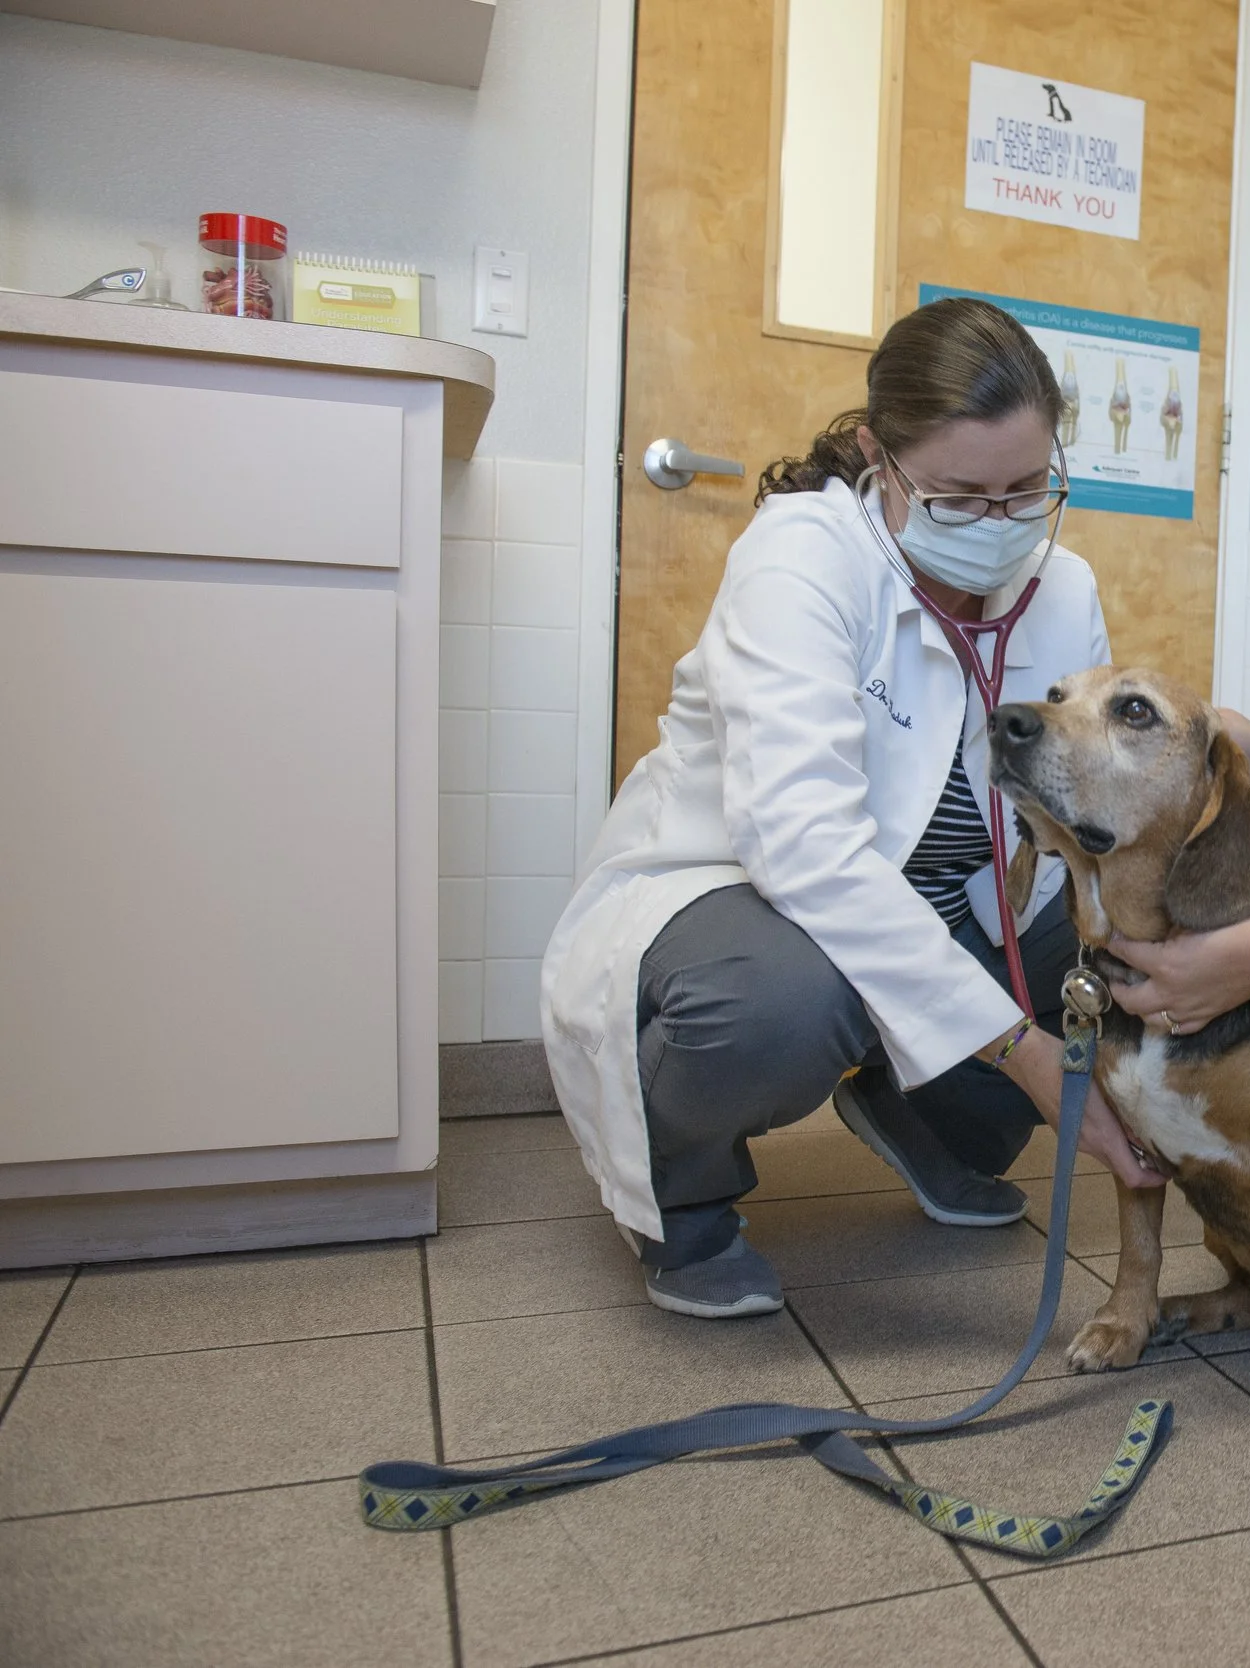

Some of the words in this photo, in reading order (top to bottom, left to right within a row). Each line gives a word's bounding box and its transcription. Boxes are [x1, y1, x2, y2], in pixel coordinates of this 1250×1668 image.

[996, 116, 1033, 147] PLEASE
[1037, 125, 1071, 155] REMAIN
[1076, 134, 1085, 158] IN
[1089, 136, 1117, 164] ROOM
[972, 138, 999, 165] UNTIL
[1003, 143, 1053, 176] RELEASED
[1057, 154, 1069, 179] BY
[1073, 158, 1080, 182] A
[1084, 159, 1137, 193] TECHNICIAN
[993, 177, 1063, 209] THANK
[1073, 193, 1115, 219] YOU
[311, 307, 402, 327] Understanding
[1037, 311, 1061, 326] (OA)
[1062, 317, 1070, 327] is
[1080, 318, 1116, 334] disease
[1118, 325, 1137, 337] that
[1138, 329, 1188, 345] progresses
